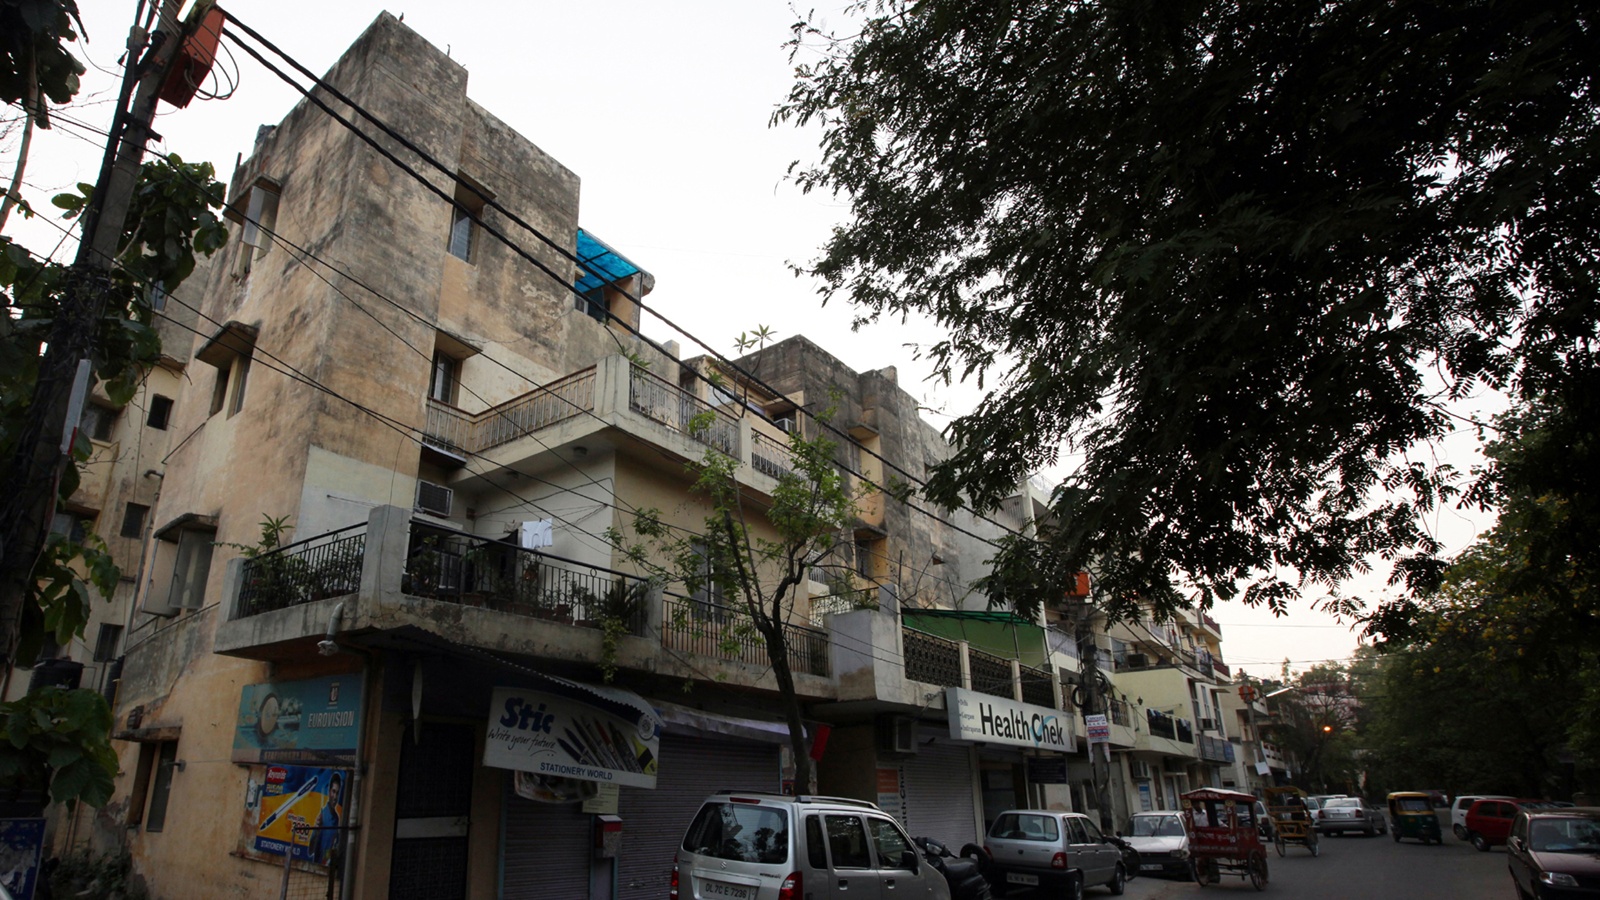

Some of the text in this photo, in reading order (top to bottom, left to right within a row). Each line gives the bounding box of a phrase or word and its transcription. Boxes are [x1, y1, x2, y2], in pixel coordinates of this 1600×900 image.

[307, 710, 355, 728] EUROVISION
[500, 697, 555, 734] Stic
[487, 727, 556, 751] Write your future
[267, 769, 287, 780] Reynolds
[540, 762, 613, 781] STATIONERY WORLD
[260, 840, 285, 852] STATIONERY
[705, 883, 713, 893] DL
[724, 886, 729, 895] E
